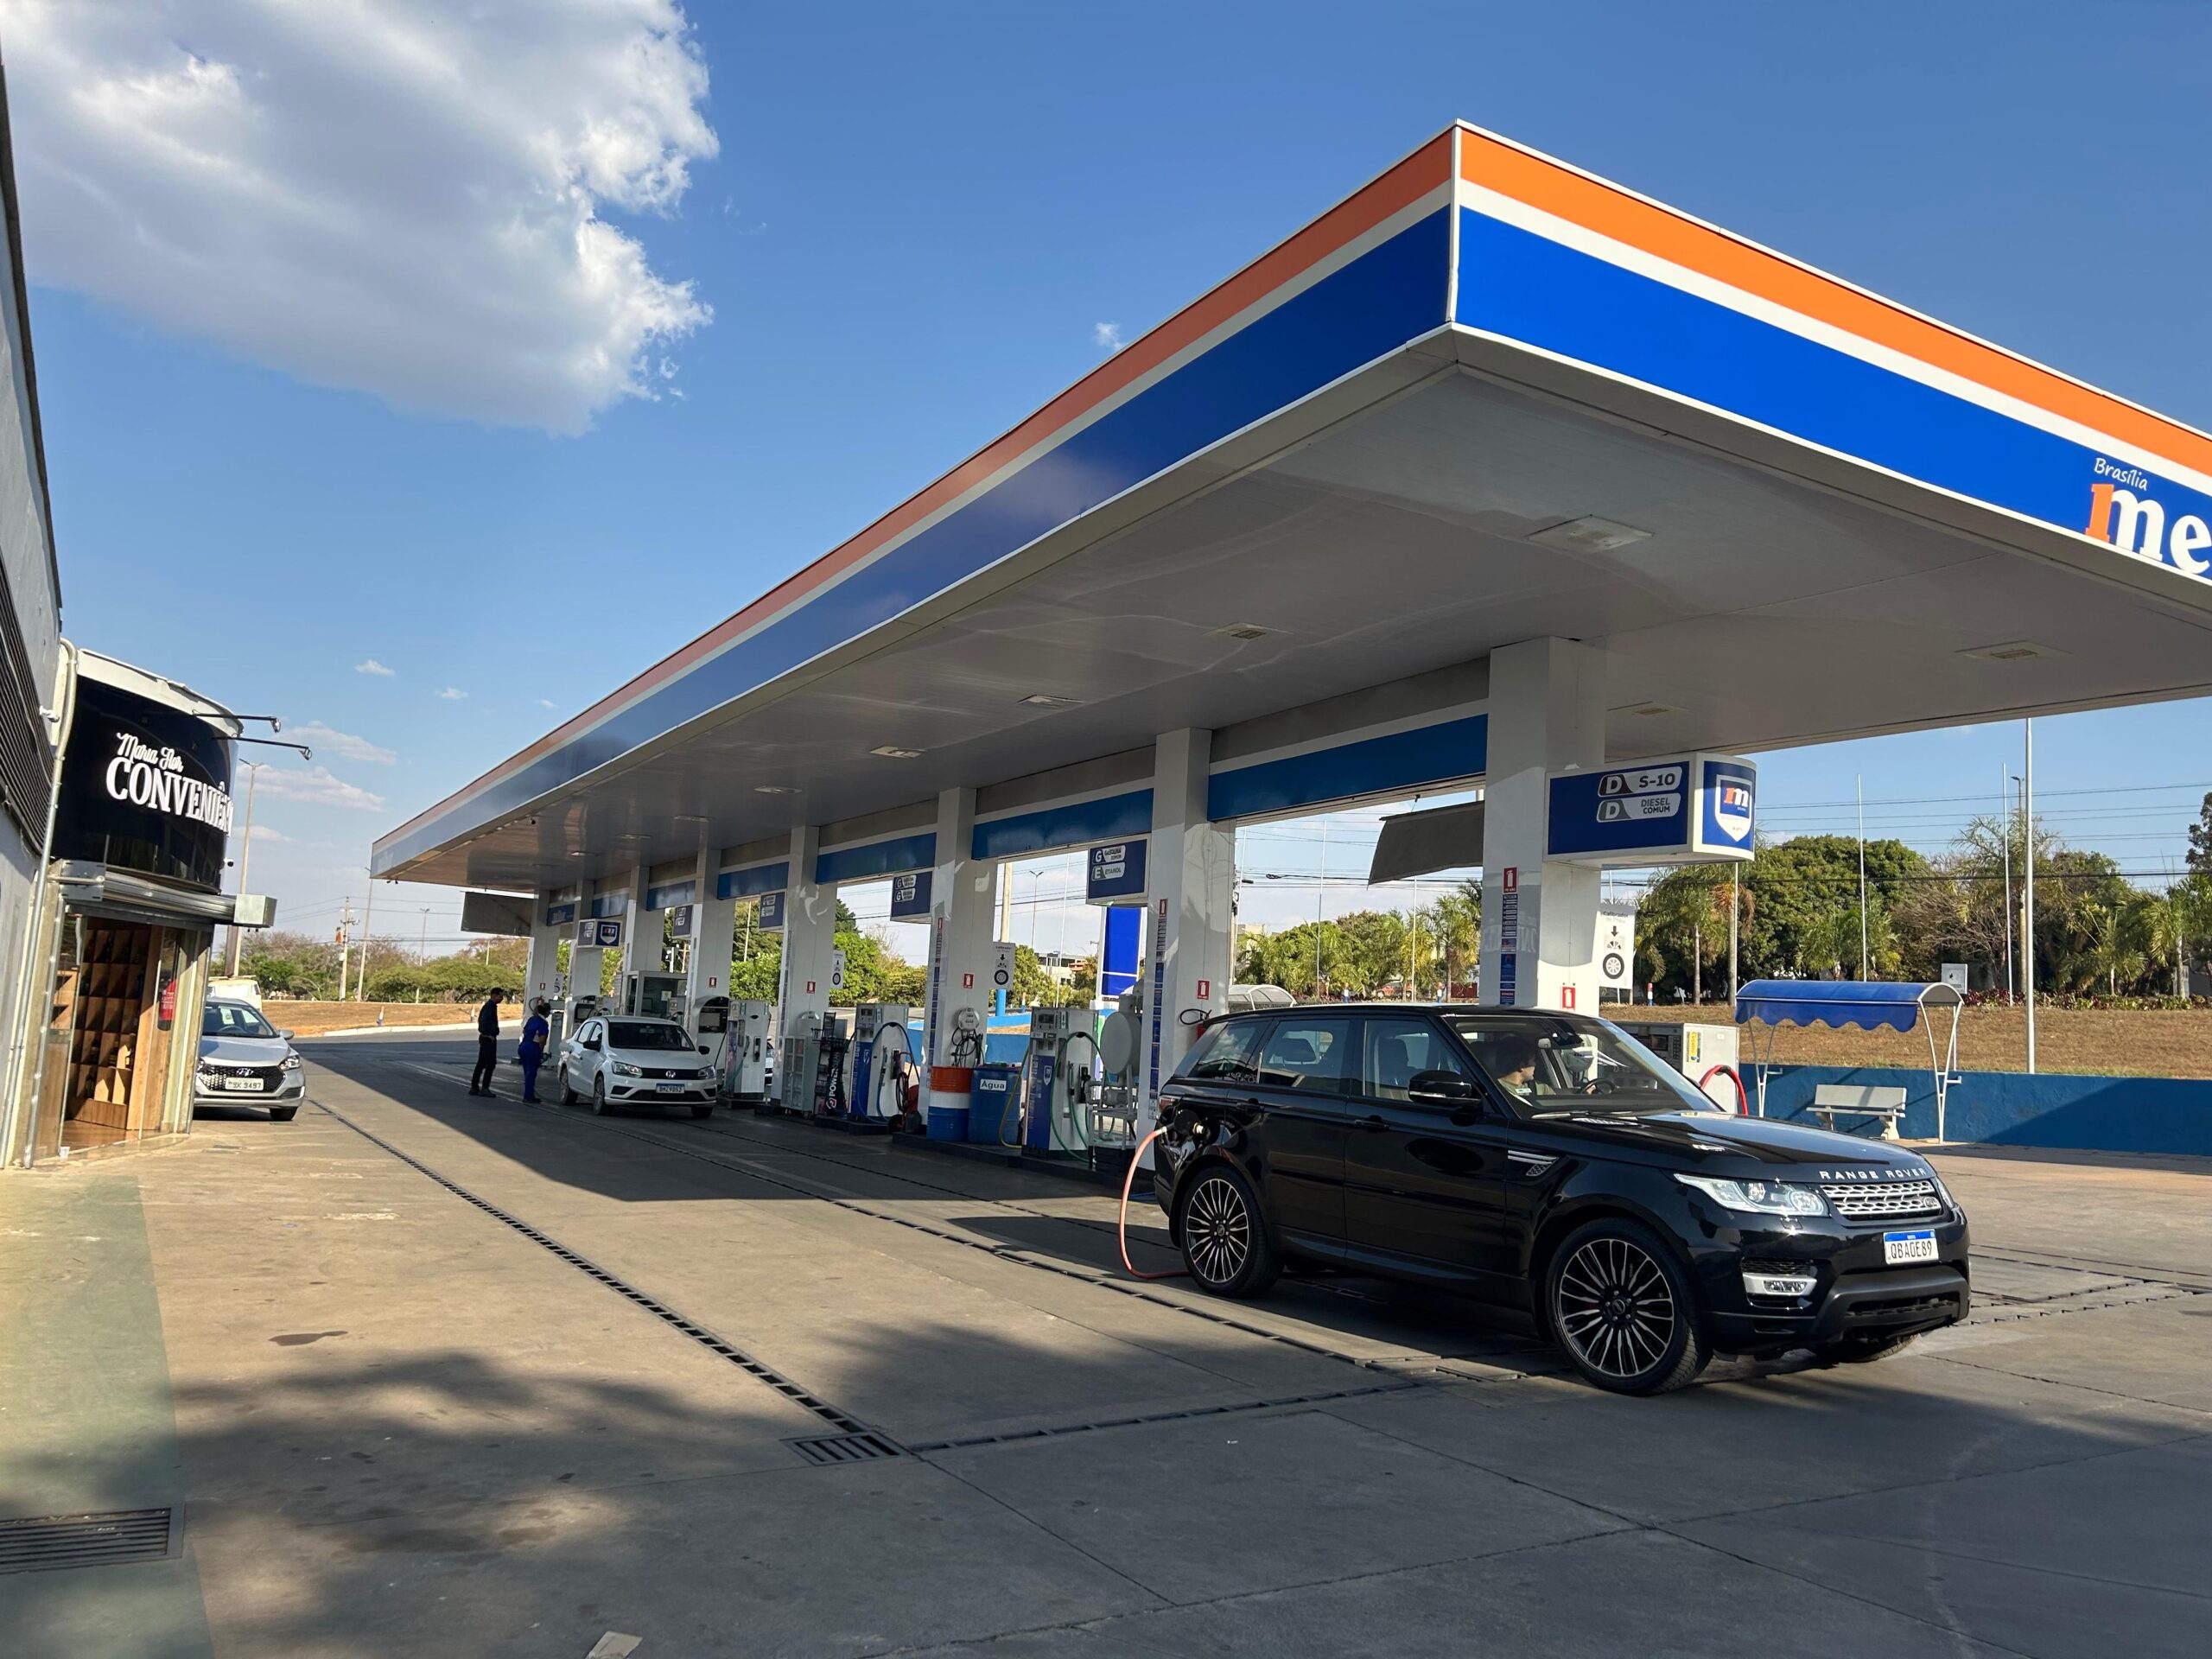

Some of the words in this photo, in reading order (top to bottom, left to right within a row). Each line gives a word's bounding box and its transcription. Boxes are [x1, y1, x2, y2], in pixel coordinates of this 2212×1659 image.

[2094, 457, 2148, 491] Brasília
[1605, 775, 1623, 794] D
[1638, 772, 1676, 788] S-10
[1605, 801, 1621, 820] D
[1641, 798, 1671, 808] DIESEL
[1643, 805, 1671, 815] COMUM
[829, 1068, 839, 1096] POWER
[1819, 1170, 1879, 1180] RANGE
[1885, 1167, 1927, 1179] ROVER
